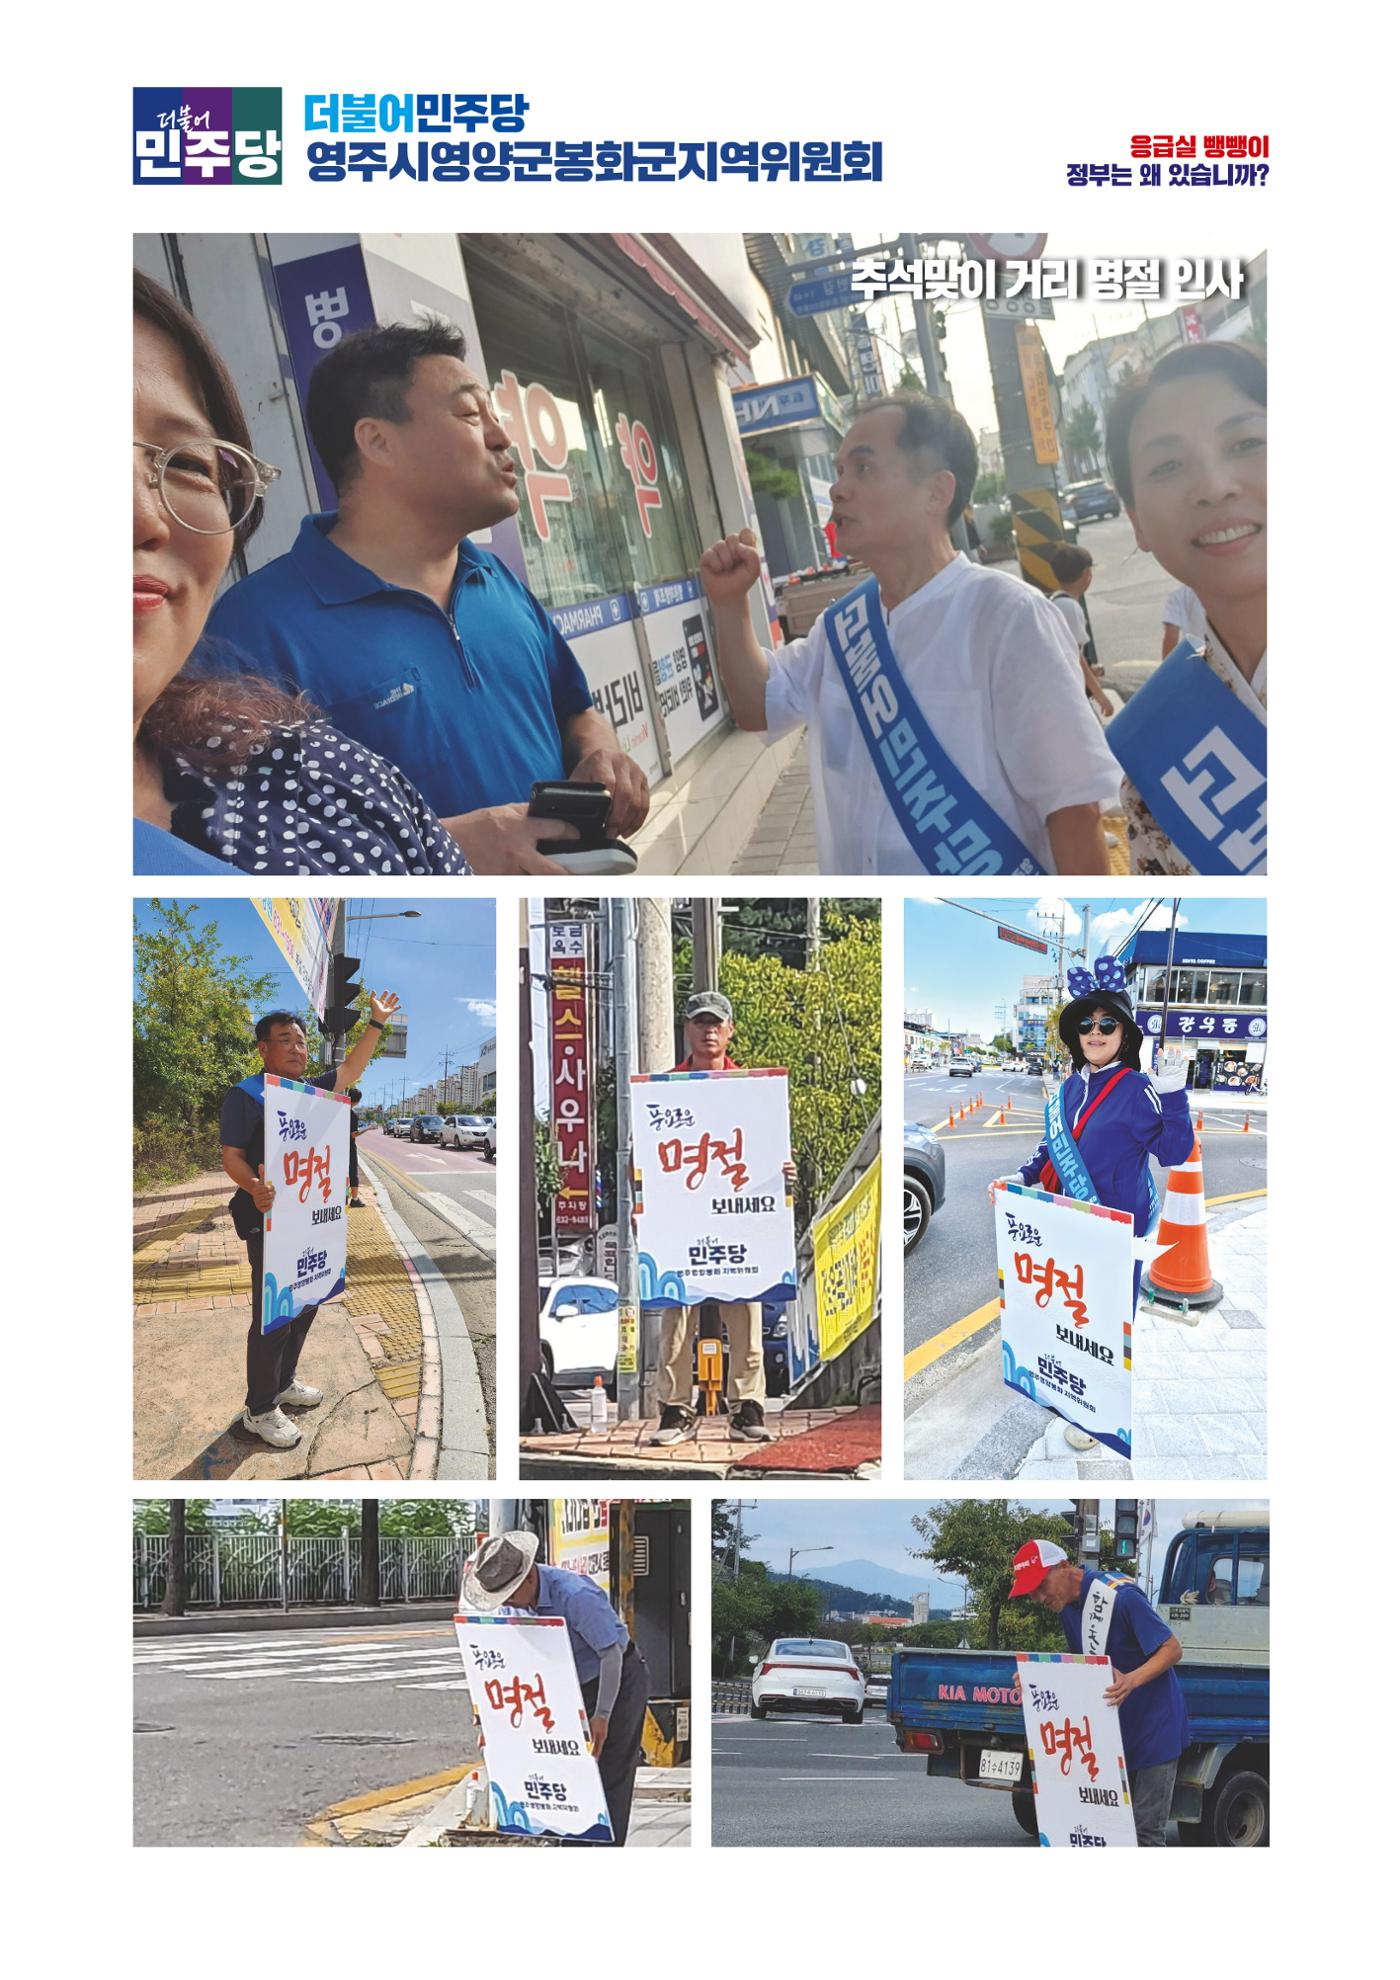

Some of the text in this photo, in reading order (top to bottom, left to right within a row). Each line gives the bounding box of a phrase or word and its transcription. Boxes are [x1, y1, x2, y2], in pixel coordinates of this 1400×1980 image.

[277, 1110, 307, 1141] 풍요로운
[646, 1104, 695, 1131] 풍요로운
[658, 1127, 749, 1192] 명절
[283, 1145, 331, 1203] 명절
[311, 1205, 342, 1226] 보내세요
[712, 1196, 776, 1215] 보내세요
[1005, 1211, 1043, 1247] 풍요로운
[297, 1250, 327, 1278] 민주당
[688, 1244, 747, 1266] 민주당
[1014, 1251, 1090, 1329] 명절
[1056, 1324, 1115, 1367] 보내세요
[1037, 1356, 1087, 1397] 민주당
[484, 1672, 556, 1735] 명절
[938, 1684, 966, 1701] KIA
[1028, 1683, 1060, 1712] 풍요로운
[532, 1738, 582, 1756] 보내세요
[1040, 1715, 1099, 1783] 명절
[980, 1758, 1021, 1776] 81수4139
[524, 1781, 567, 1802] 민주당
[1079, 1786, 1120, 1808] 보내세요
